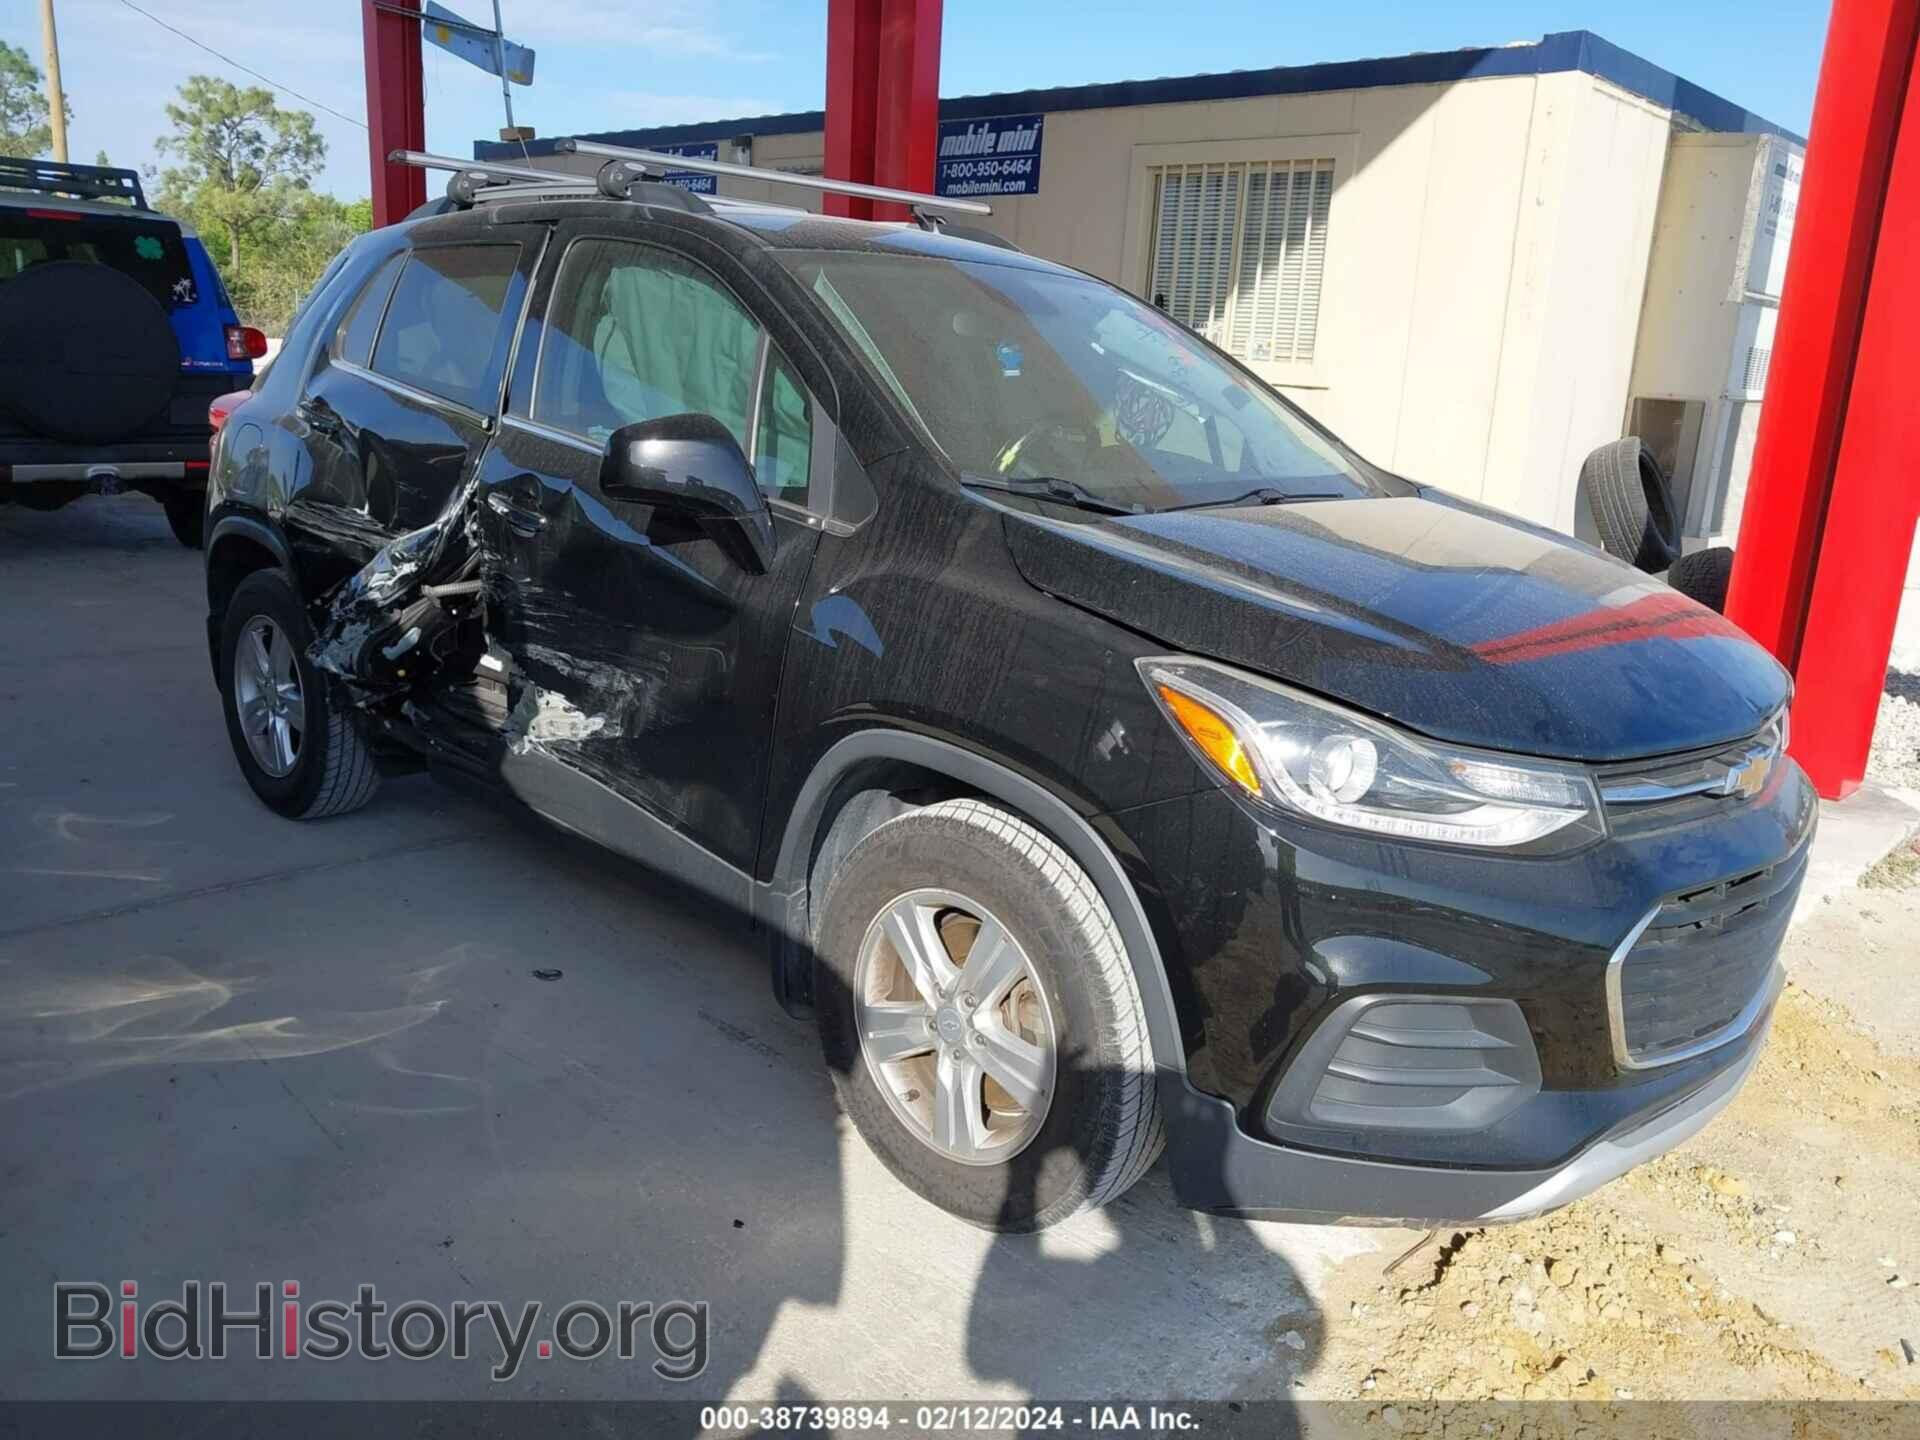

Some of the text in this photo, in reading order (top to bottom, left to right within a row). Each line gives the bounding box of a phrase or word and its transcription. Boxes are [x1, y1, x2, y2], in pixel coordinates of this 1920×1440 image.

[940, 122, 1040, 156] mobile mini
[941, 159, 1033, 178] 1-800-950-6464
[945, 179, 1026, 195] mobilemini.com
